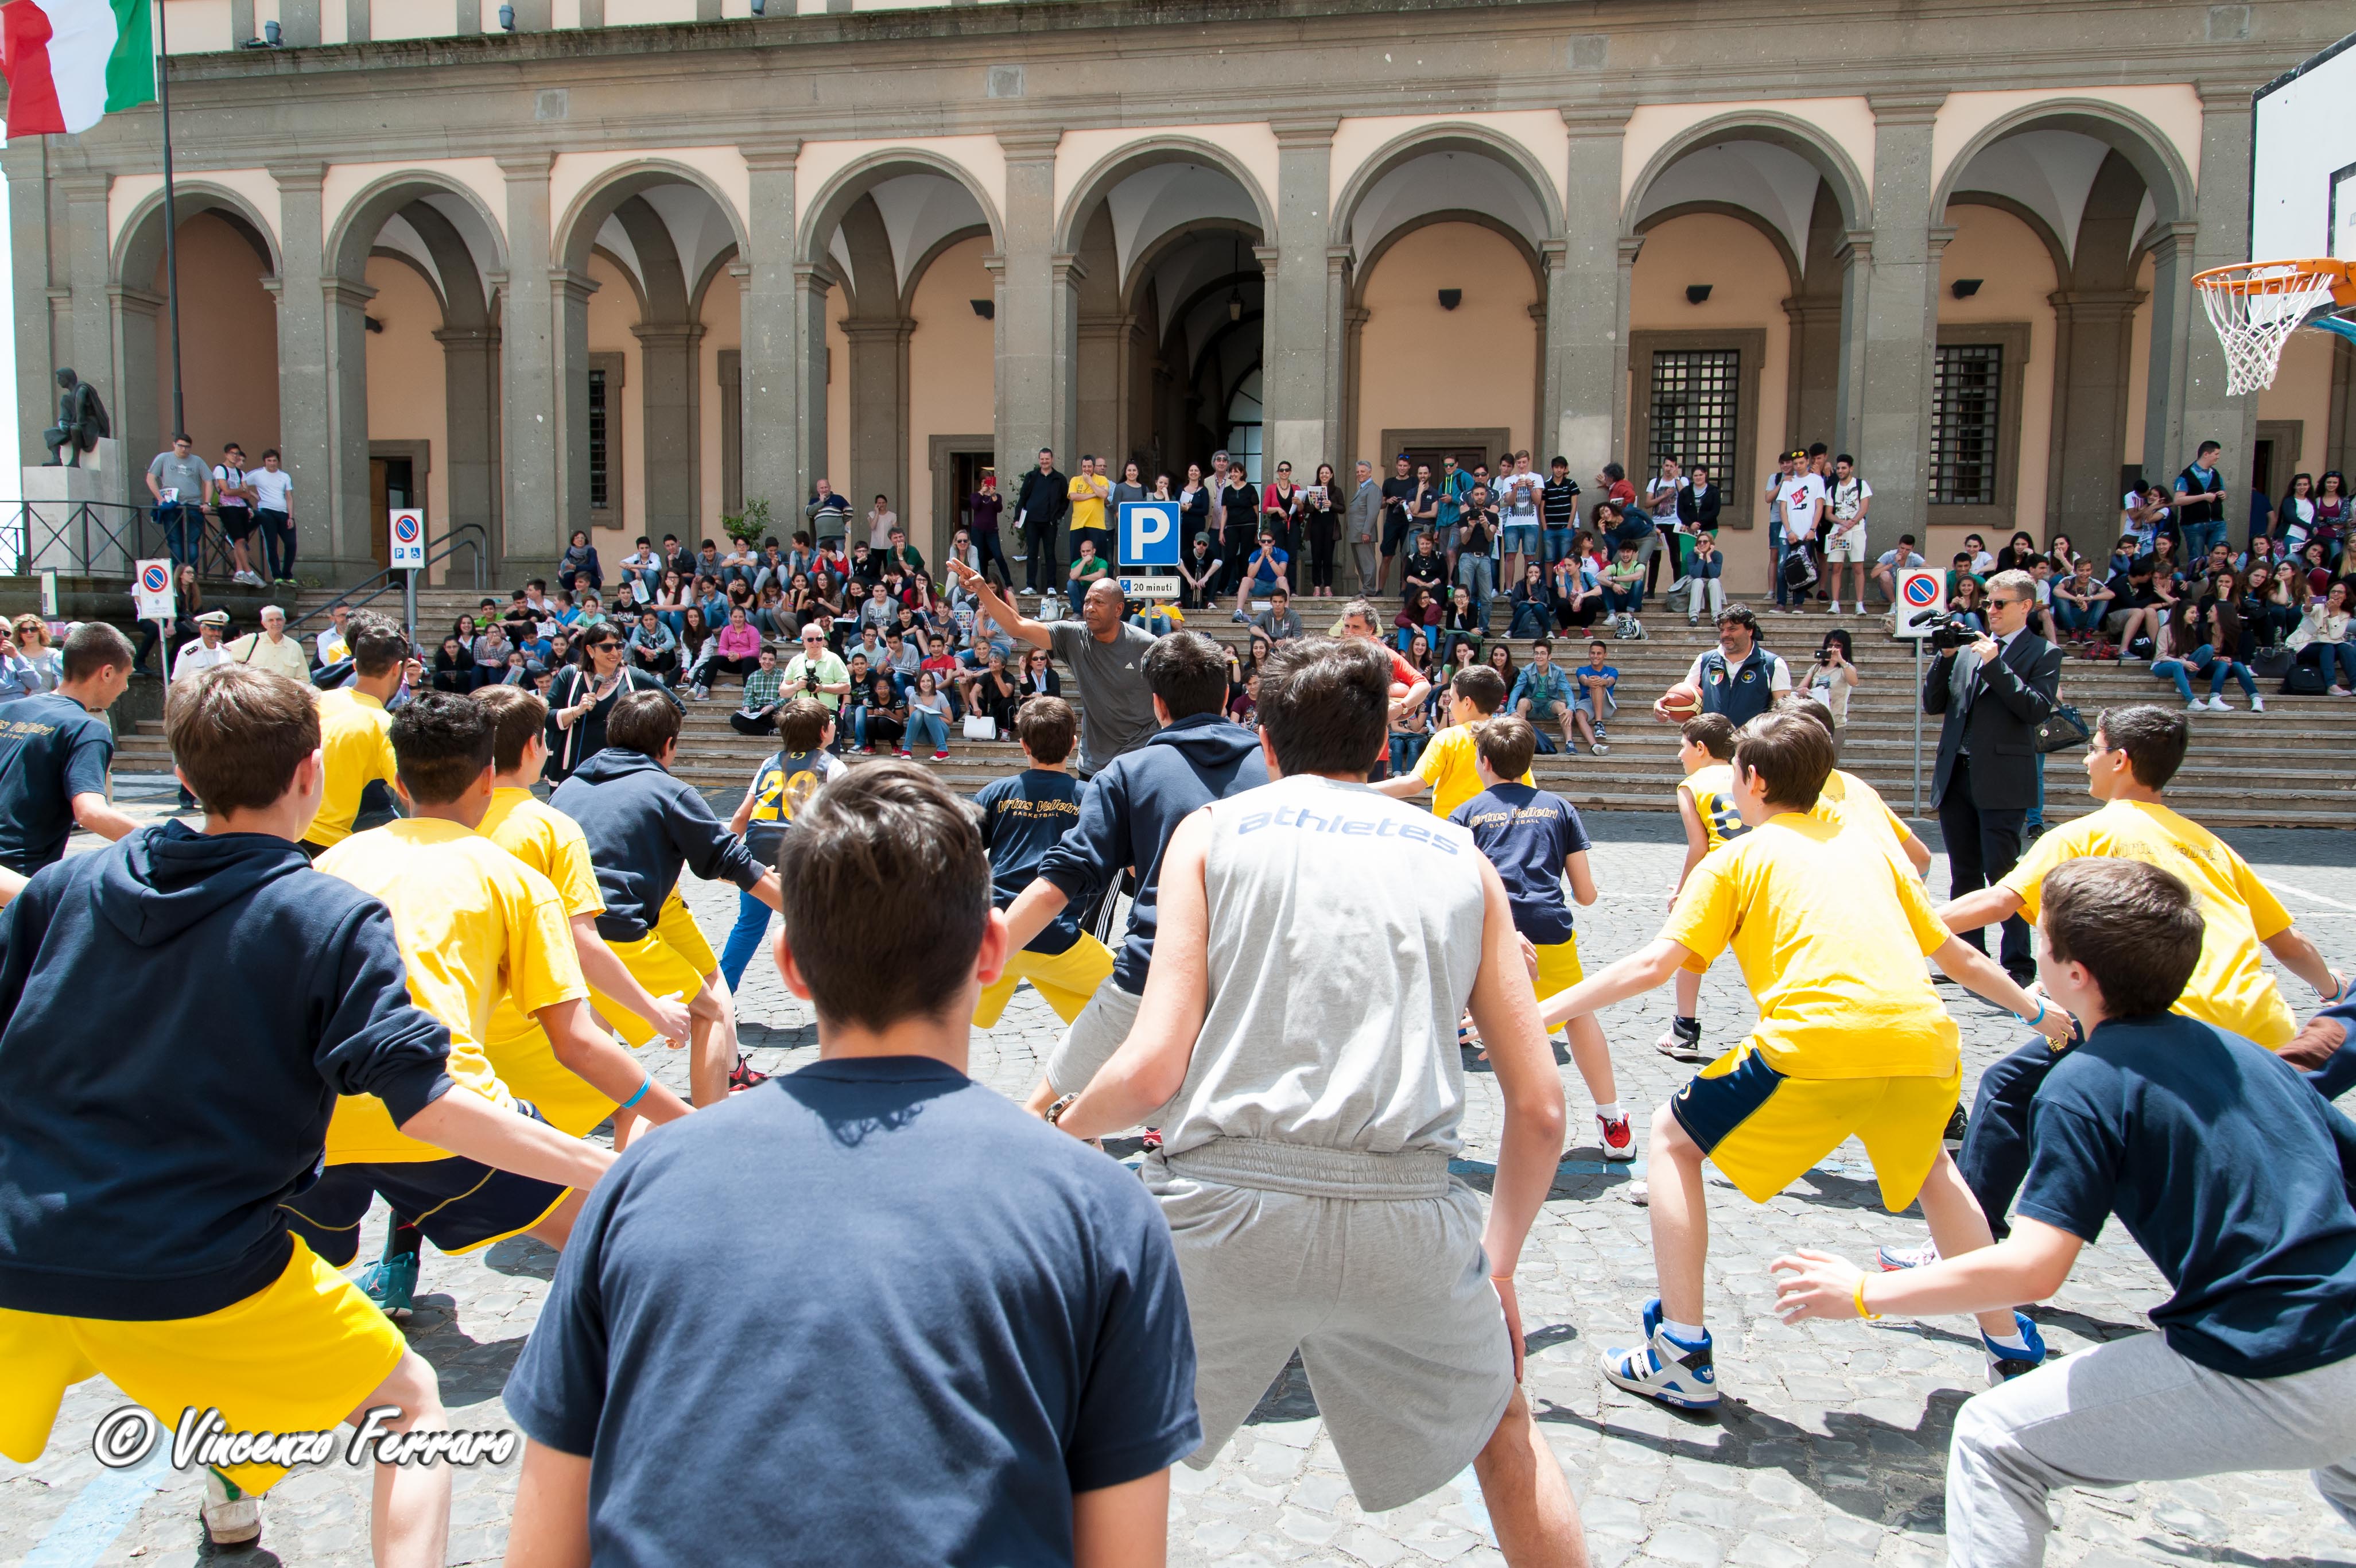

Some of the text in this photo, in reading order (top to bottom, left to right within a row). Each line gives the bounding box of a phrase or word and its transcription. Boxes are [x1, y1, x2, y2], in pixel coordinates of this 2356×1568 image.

[1131, 508, 1170, 560] P
[396, 549, 403, 558] P
[1134, 583, 1172, 591] 20 minuti
[1511, 806, 1559, 820] Velletri
[1238, 805, 1459, 856] athletes
[1667, 1396, 1684, 1406] SPORT
